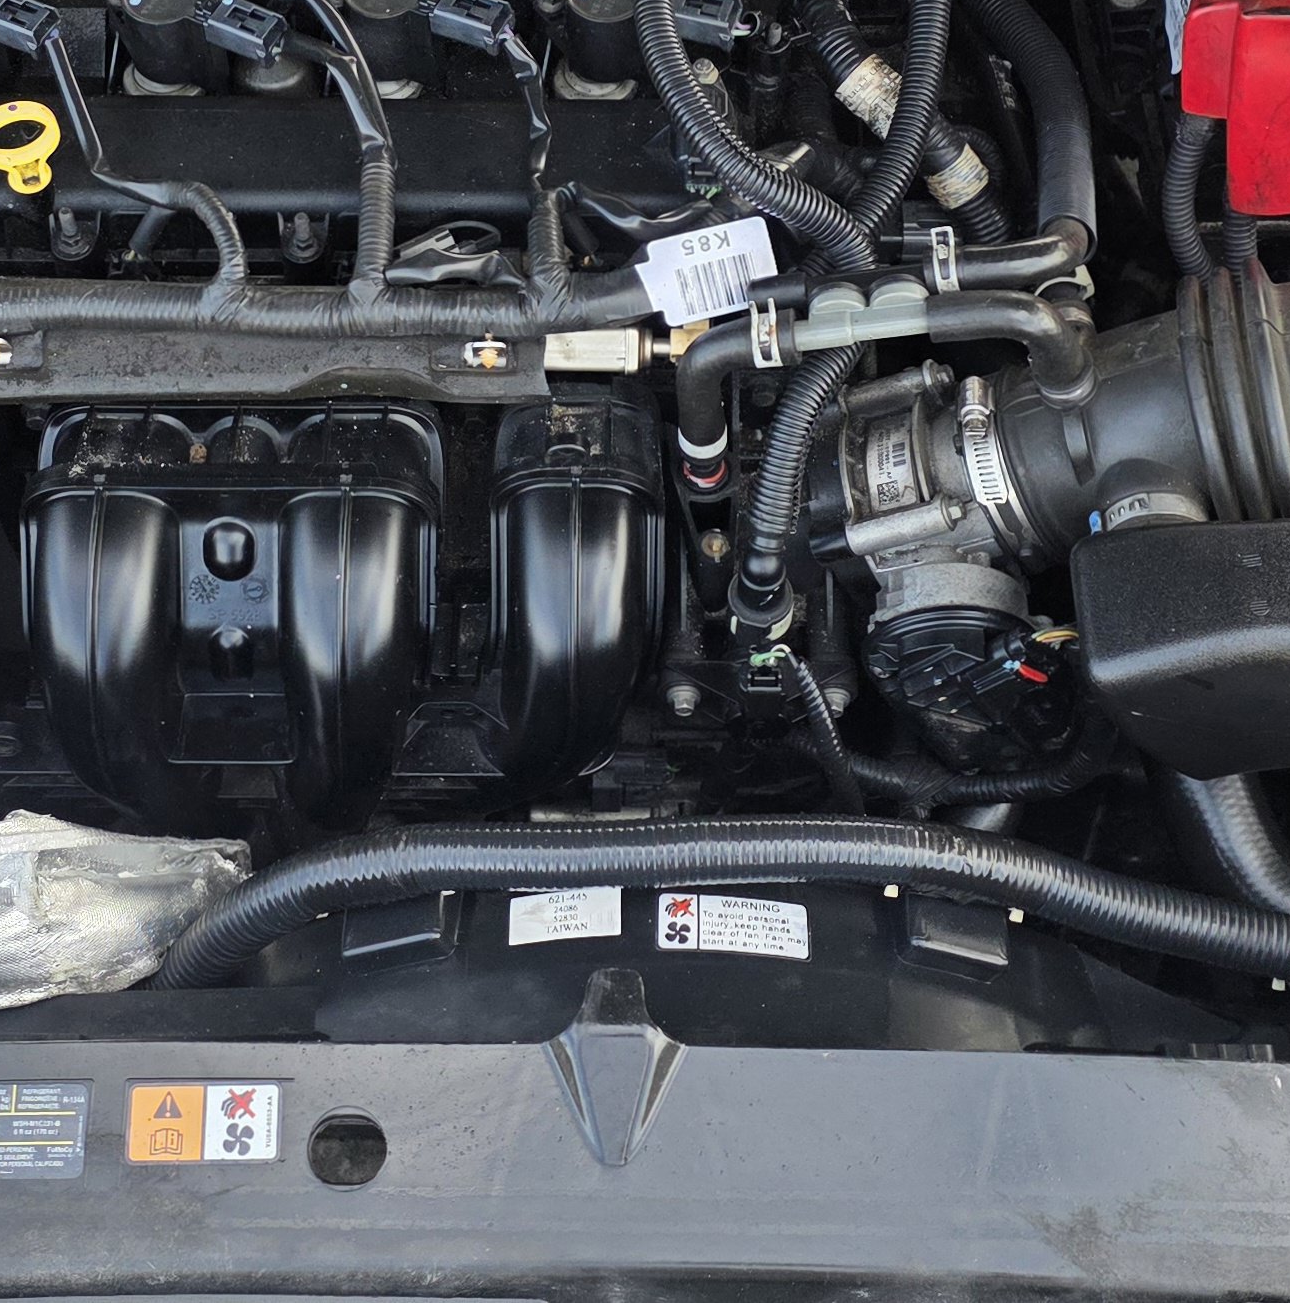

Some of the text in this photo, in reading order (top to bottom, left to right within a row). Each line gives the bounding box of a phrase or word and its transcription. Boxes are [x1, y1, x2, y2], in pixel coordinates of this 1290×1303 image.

[681, 230, 731, 256] K85
[721, 900, 780, 913] WARNING
[703, 910, 714, 918] To
[748, 915, 790, 925] personal
[545, 922, 588, 934] TAIWAN
[762, 925, 791, 934] hands
[702, 929, 726, 937] clear
[765, 933, 783, 942] Fan
[787, 936, 807, 947] may
[702, 938, 724, 946] start
[742, 941, 760, 950] any
